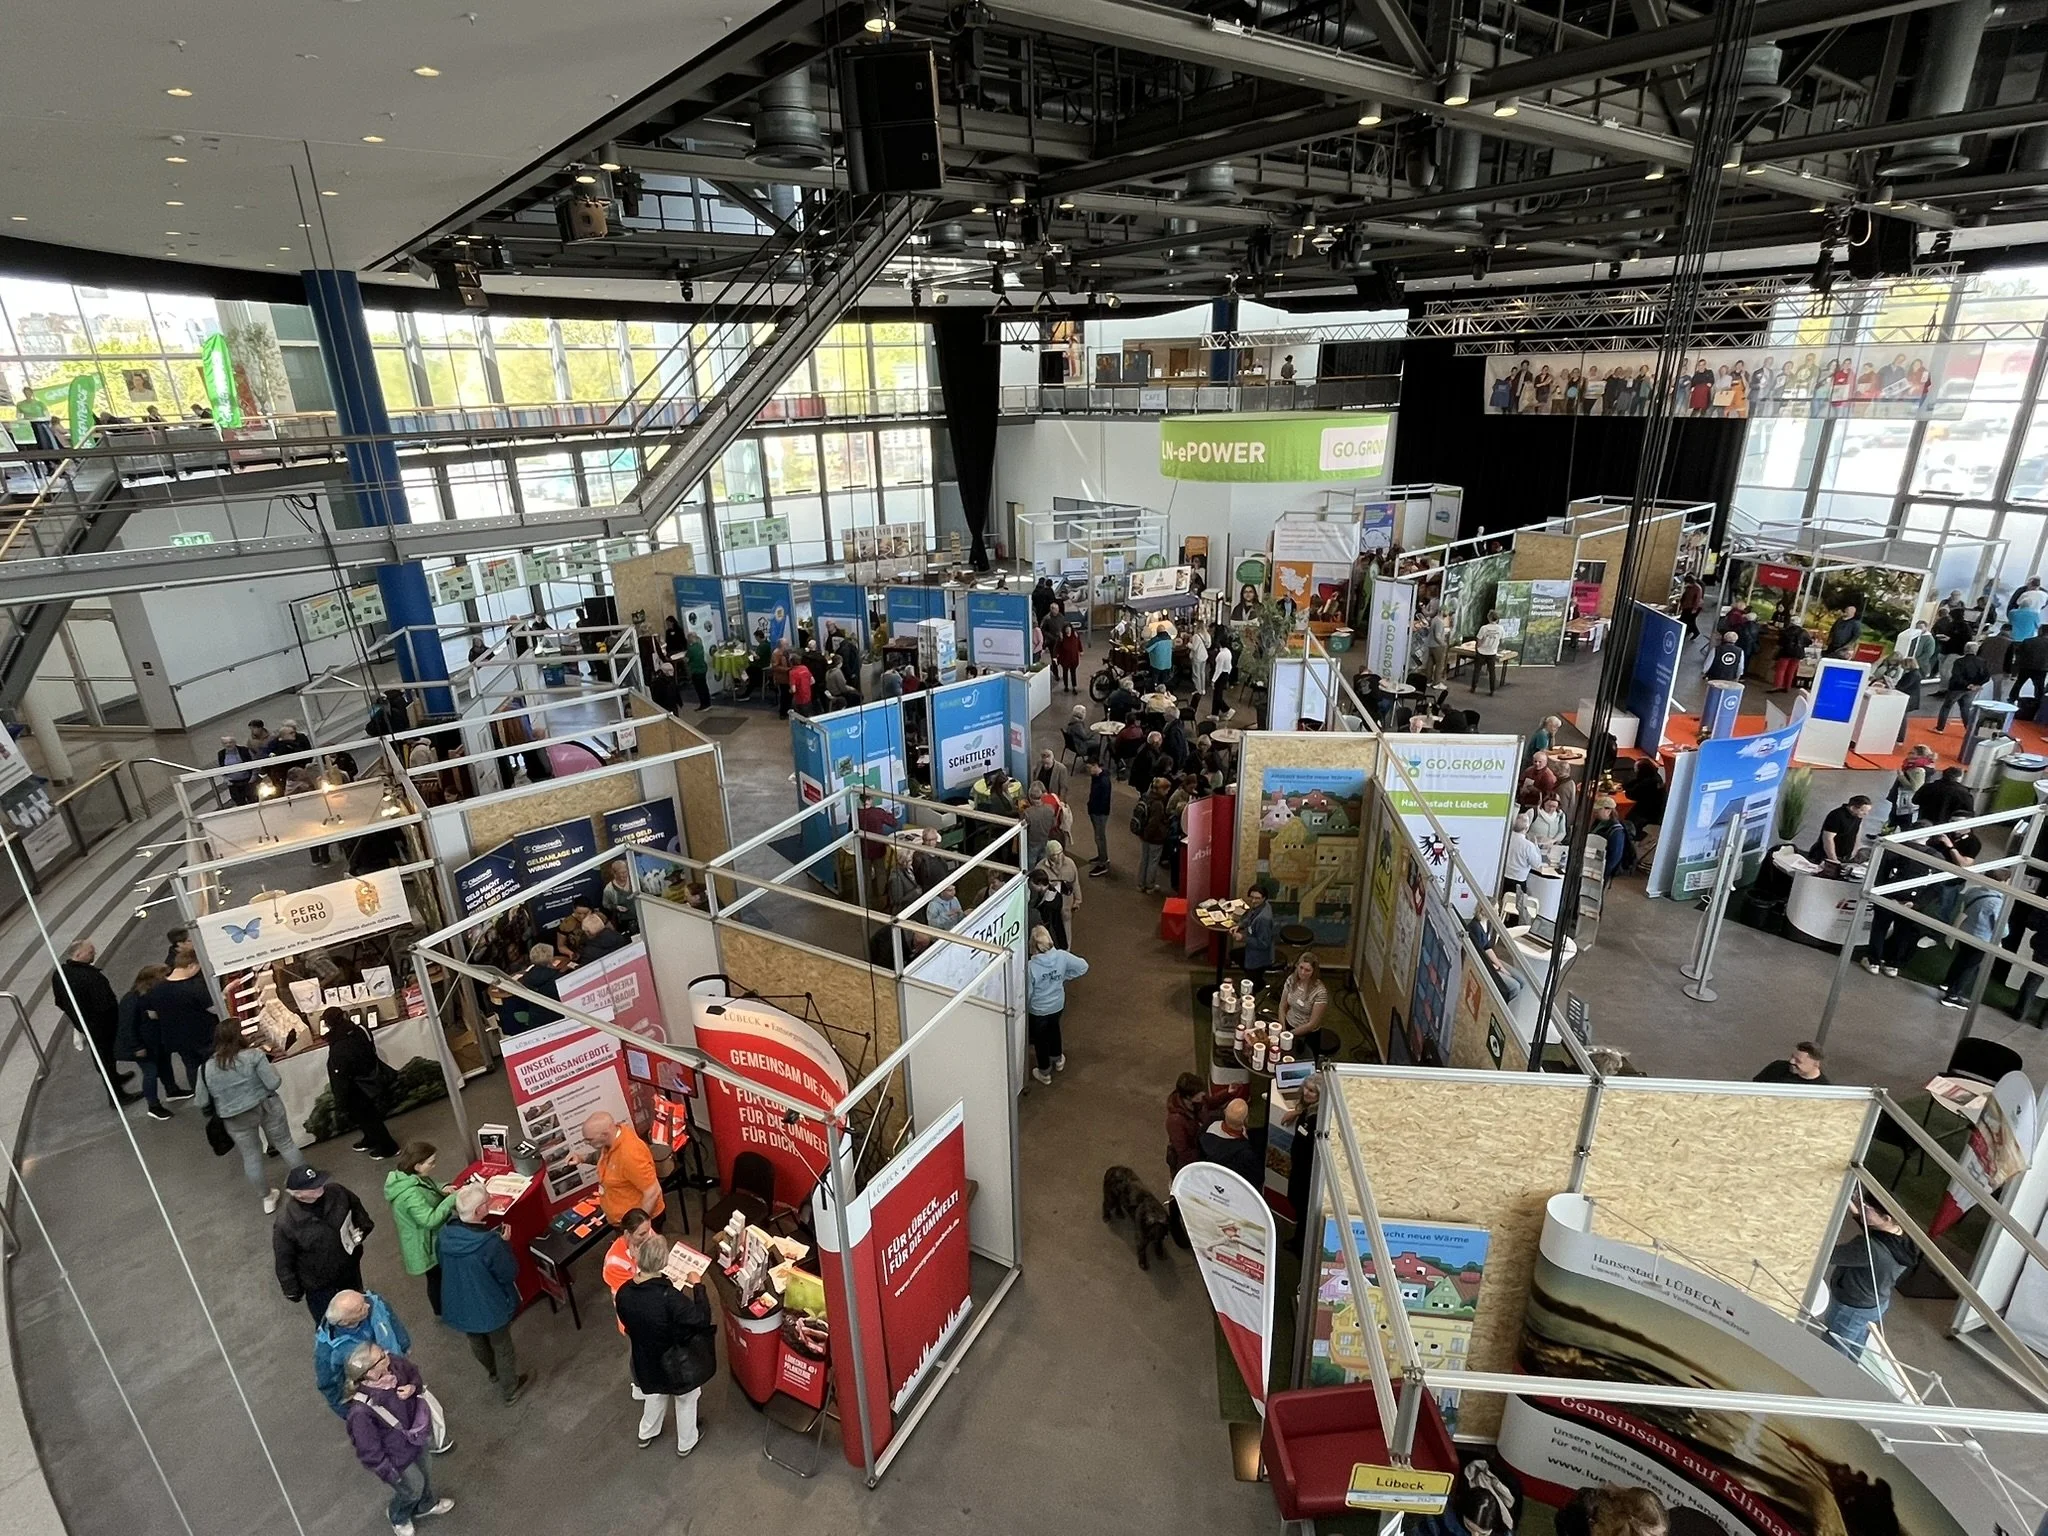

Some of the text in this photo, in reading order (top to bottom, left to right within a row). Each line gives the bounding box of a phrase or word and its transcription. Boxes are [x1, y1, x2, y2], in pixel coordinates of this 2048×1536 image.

[1162, 440, 1266, 464] LN-ePOWER
[948, 748, 996, 769] SCHETTLERs
[1425, 758, 1505, 771] GO.GRØØN
[1455, 800, 1489, 809] Lübeck
[614, 828, 653, 844] GUTES GELD
[526, 845, 584, 867] GELDANLAGE MIT
[527, 860, 562, 874] WIRKUNG
[465, 878, 500, 903] GELD MACHT
[466, 896, 484, 911] NICHT
[293, 910, 327, 926] PURO
[724, 1012, 762, 1027] LÜBECK
[519, 1054, 556, 1076] UNSERE
[523, 1043, 610, 1087] BILDUNGSANGEBOTE
[730, 1048, 820, 1095] GEMEINSAM DIE
[738, 1107, 765, 1125] FÜR
[767, 1114, 785, 1132] DIE
[741, 1126, 767, 1145] FÜR
[872, 1170, 900, 1199] LÜBECK
[889, 1189, 959, 1275] FÜR DIE UMWELT!
[1384, 1230, 1406, 1239] ucht
[1434, 1234, 1470, 1244] Wärme
[887, 1232, 907, 1259] FÜR
[1593, 1253, 1660, 1282] Hansestadt
[1665, 1277, 1723, 1311] LÜBECK
[1551, 1437, 1664, 1496] Für ein lebenswertes
[1553, 1426, 1592, 1446] Unsere
[1594, 1441, 1628, 1463] Vision
[1630, 1461, 1644, 1472] zu
[1646, 1468, 1685, 1498] Fairem
[1560, 1395, 1792, 1536] Gemeinsam auf Klima
[1376, 1477, 1425, 1491] Lübeck
